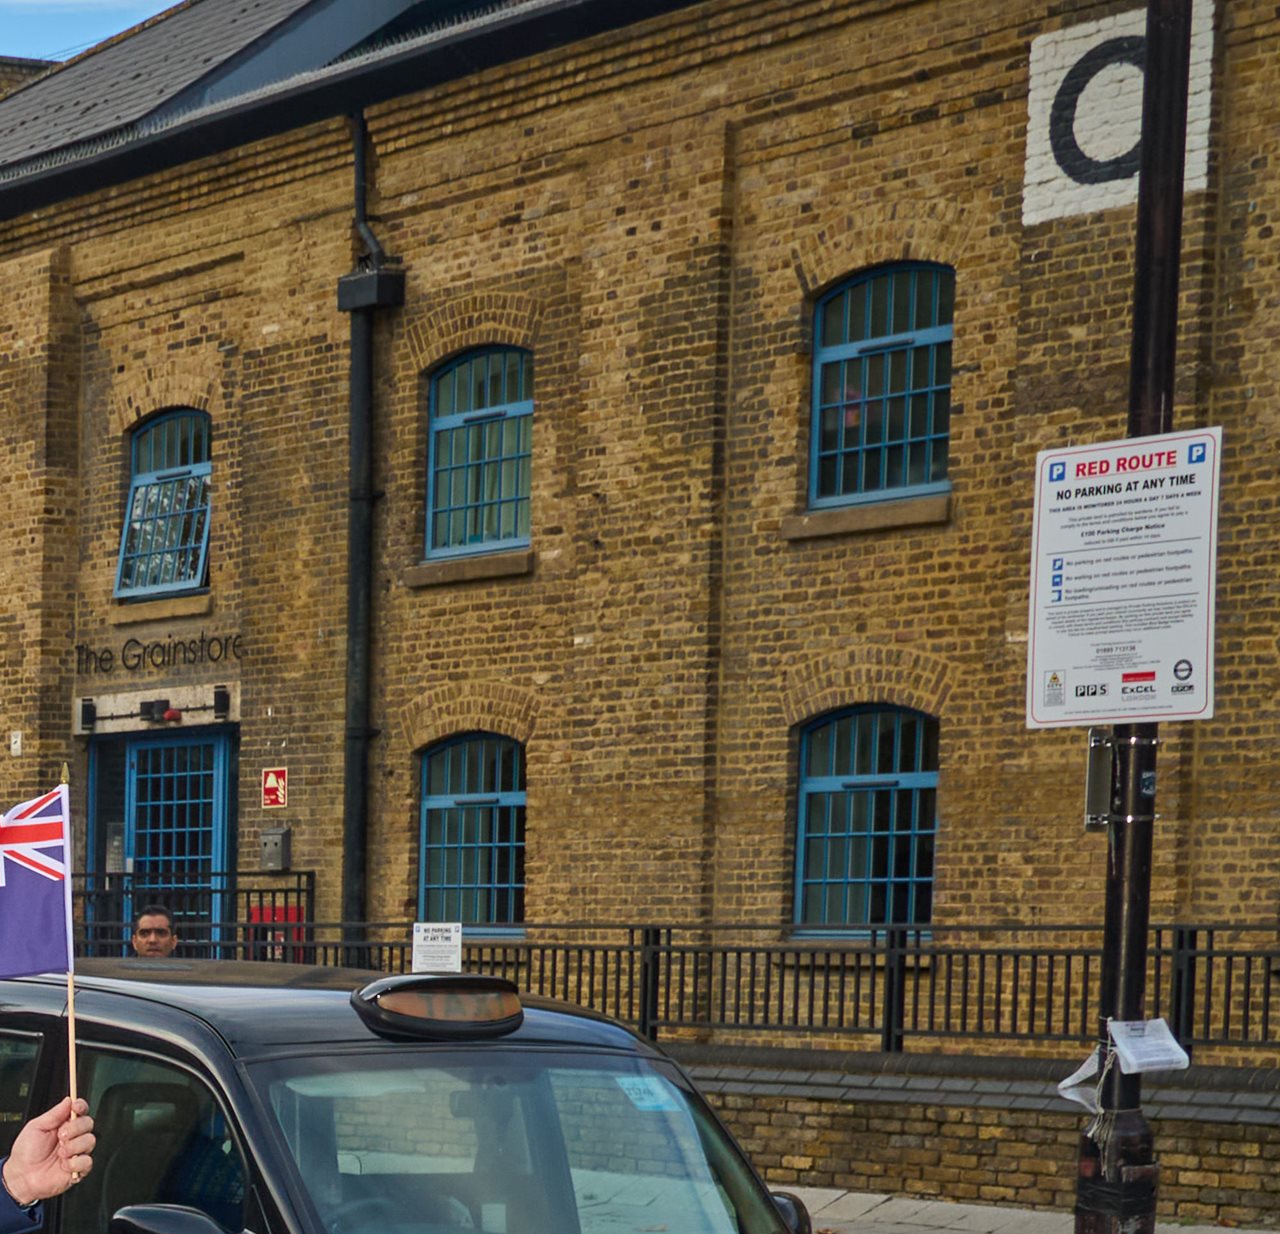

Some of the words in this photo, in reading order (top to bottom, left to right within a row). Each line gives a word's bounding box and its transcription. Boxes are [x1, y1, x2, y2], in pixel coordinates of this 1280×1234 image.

[1075, 459, 1109, 477] RED
[1116, 450, 1176, 471] ROUTE
[1056, 489, 1071, 500] NO
[1074, 483, 1122, 498] PARKING
[1125, 481, 1139, 492] AT
[1142, 478, 1165, 490] ANY
[1170, 474, 1195, 486] TIME
[1097, 528, 1119, 536] Parking
[1121, 525, 1142, 533] Charge
[75, 642, 114, 674] The
[122, 630, 241, 671] Grainstore
[417, 992, 505, 1017] TAXI
